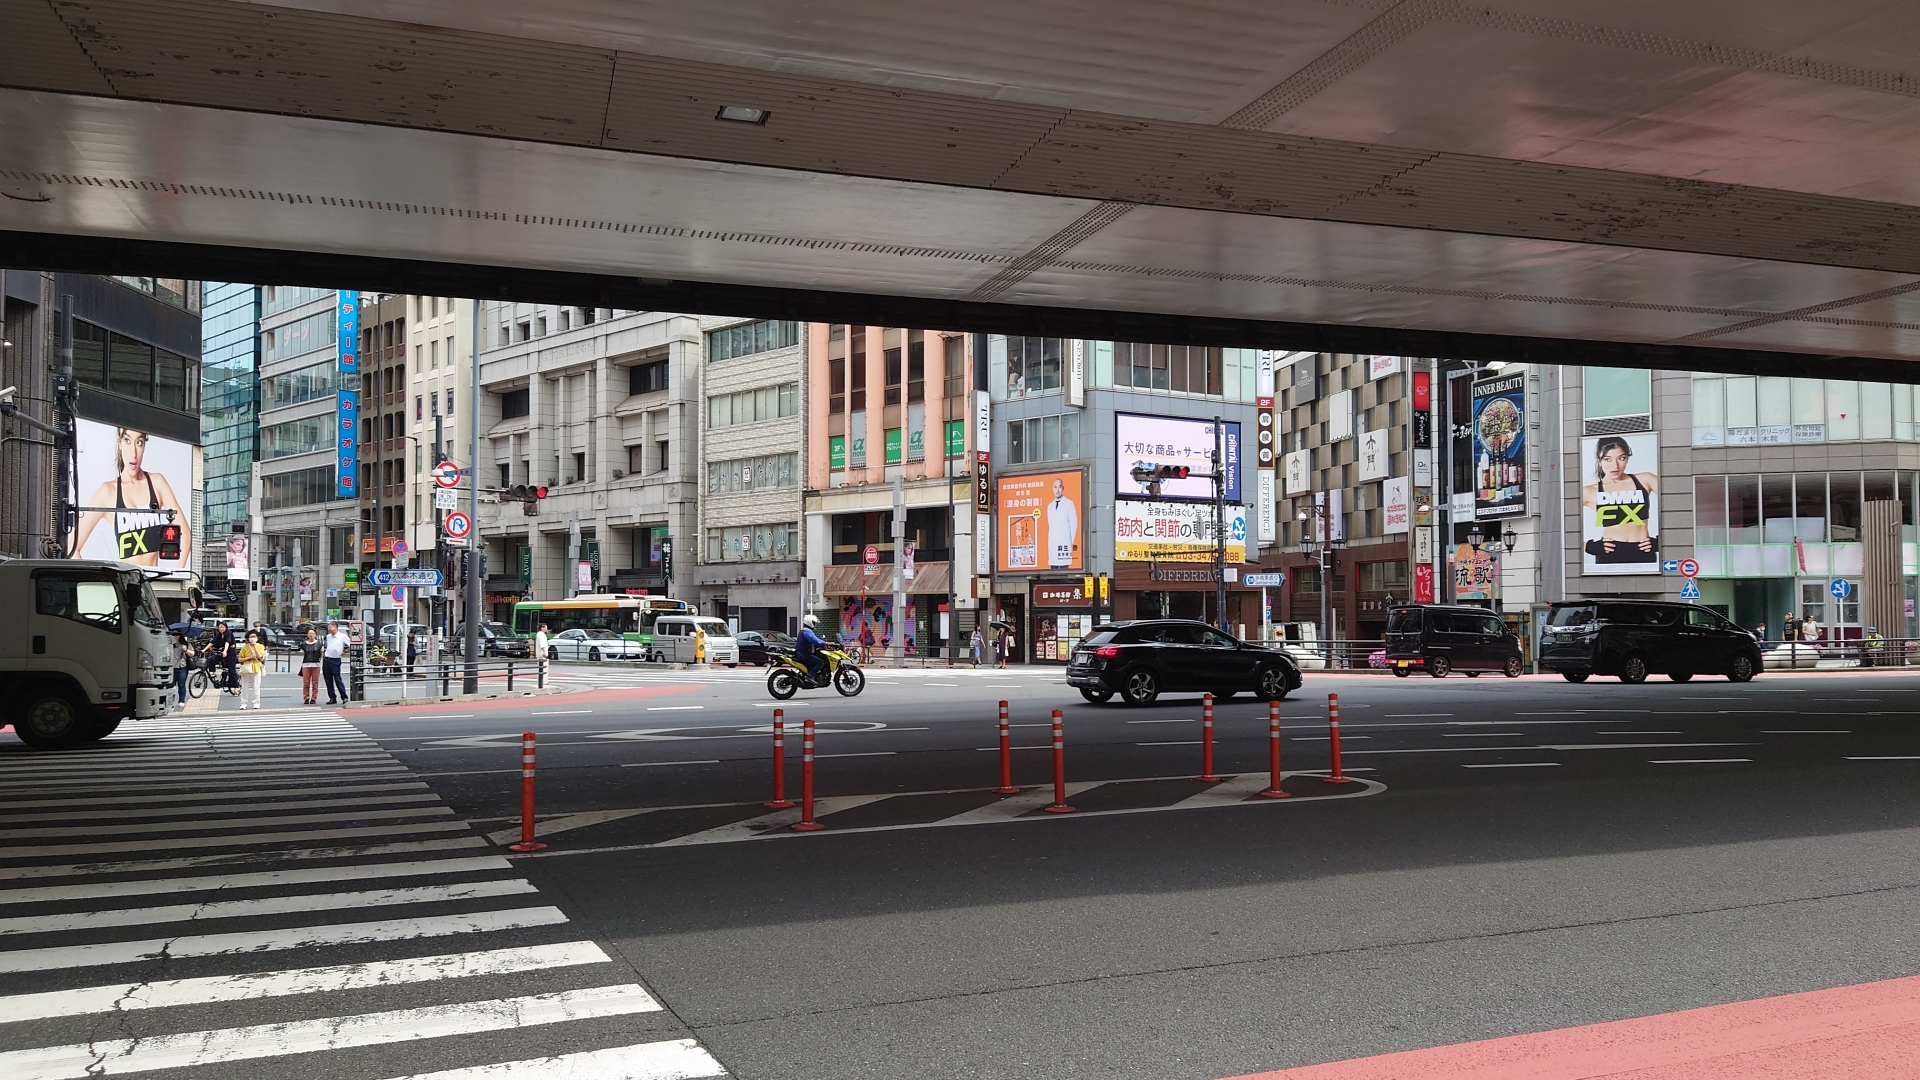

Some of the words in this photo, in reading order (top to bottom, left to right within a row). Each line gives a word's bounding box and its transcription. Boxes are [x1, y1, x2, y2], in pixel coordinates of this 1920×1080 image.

[1474, 383, 1496, 398] INNER
[1496, 377, 1524, 393] BEAUTY
[342, 400, 353, 487] カラオケ館
[852, 450, 865, 458] note
[910, 443, 925, 452] note
[979, 464, 988, 504] ゆるり
[1262, 476, 1270, 534] DIFFERENCE
[1597, 489, 1645, 506] DMM
[1595, 504, 1646, 528] FX
[120, 529, 148, 559] FX
[378, 574, 390, 582] 412
[392, 571, 434, 580] 六本木通り
